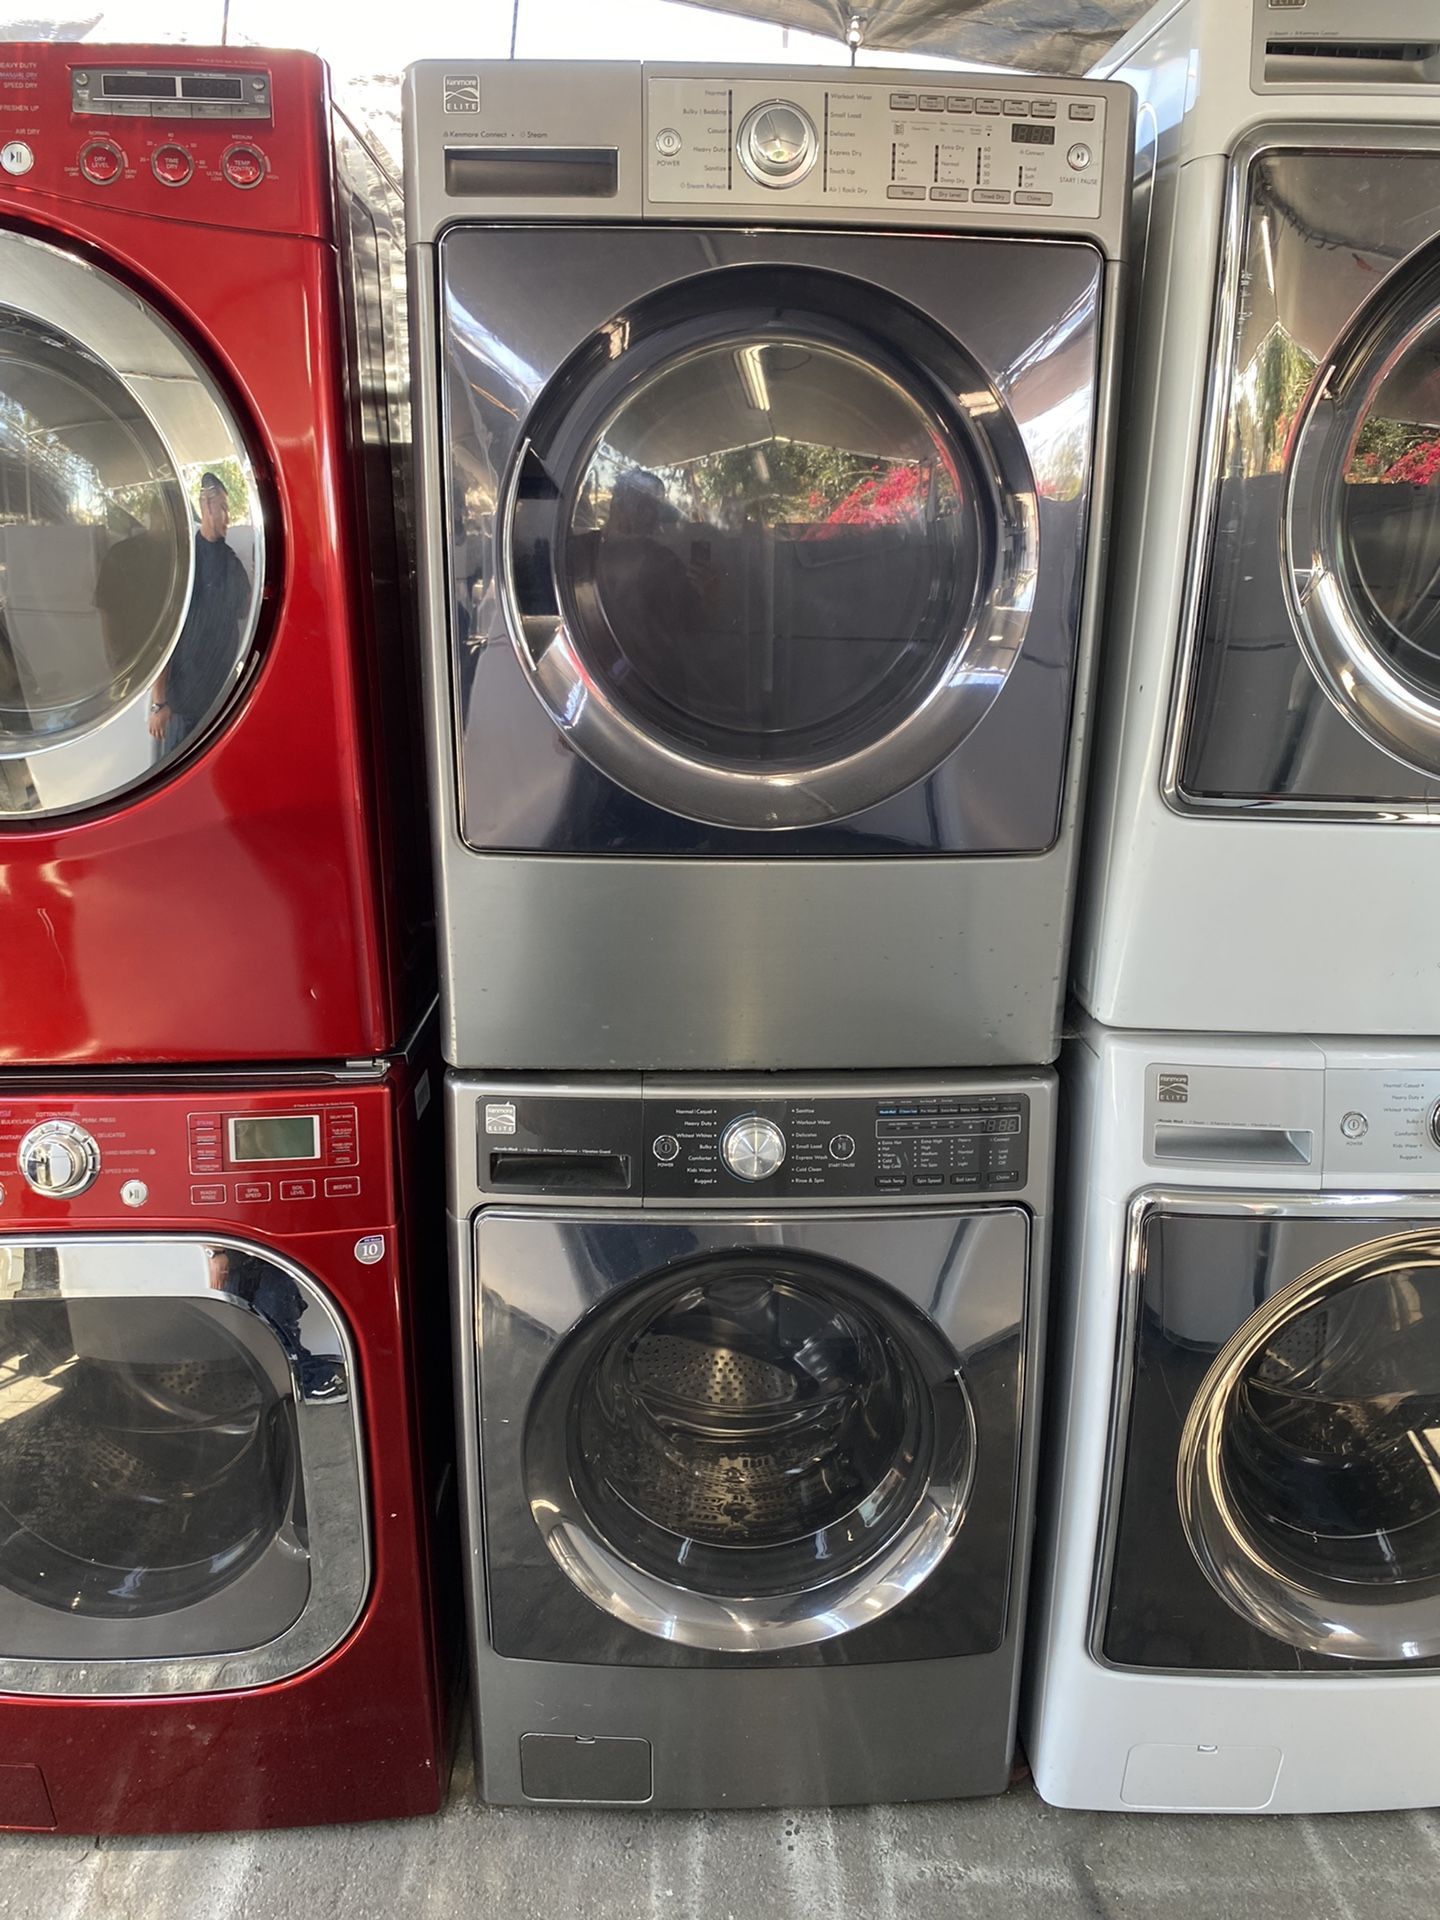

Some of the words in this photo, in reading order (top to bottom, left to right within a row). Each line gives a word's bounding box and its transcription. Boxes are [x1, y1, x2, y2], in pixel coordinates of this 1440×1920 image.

[446, 78, 477, 87] Kenmore
[447, 103, 477, 111] ELITE
[703, 108, 727, 116] Bedding
[481, 130, 507, 138] Connect
[527, 131, 548, 139] Steam
[1080, 177, 1098, 185] PAUSE
[362, 1244, 378, 1257] 10
